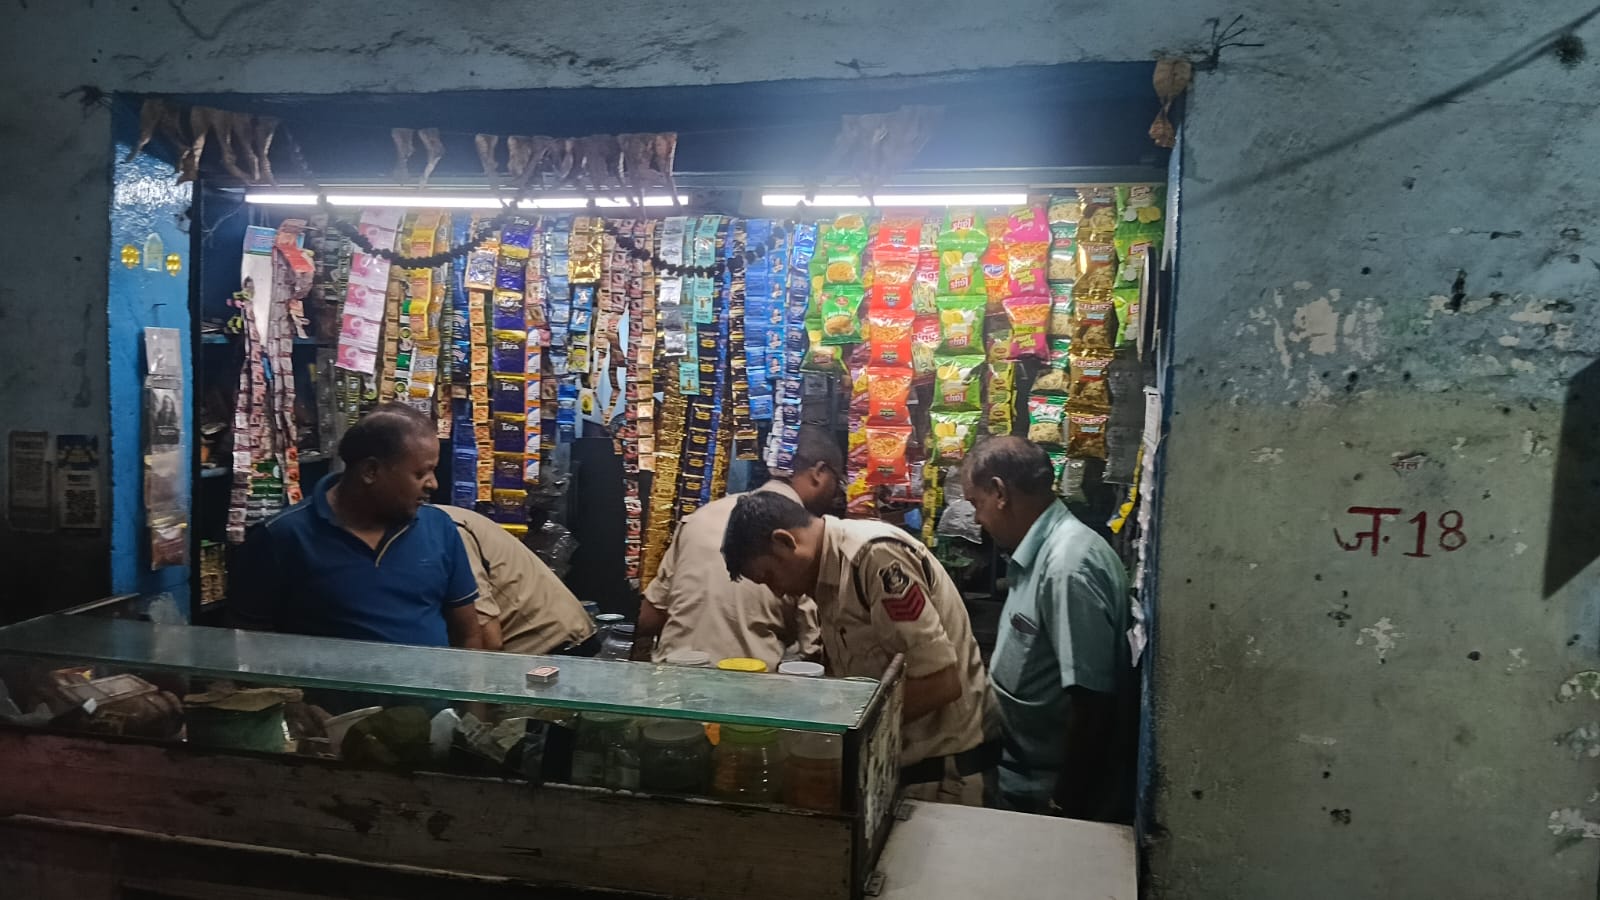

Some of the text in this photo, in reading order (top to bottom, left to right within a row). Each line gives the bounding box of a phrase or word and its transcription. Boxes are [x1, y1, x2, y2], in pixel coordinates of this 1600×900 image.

[501, 341, 520, 350] Tara
[500, 382, 519, 391] Tara
[500, 422, 519, 431] Tara
